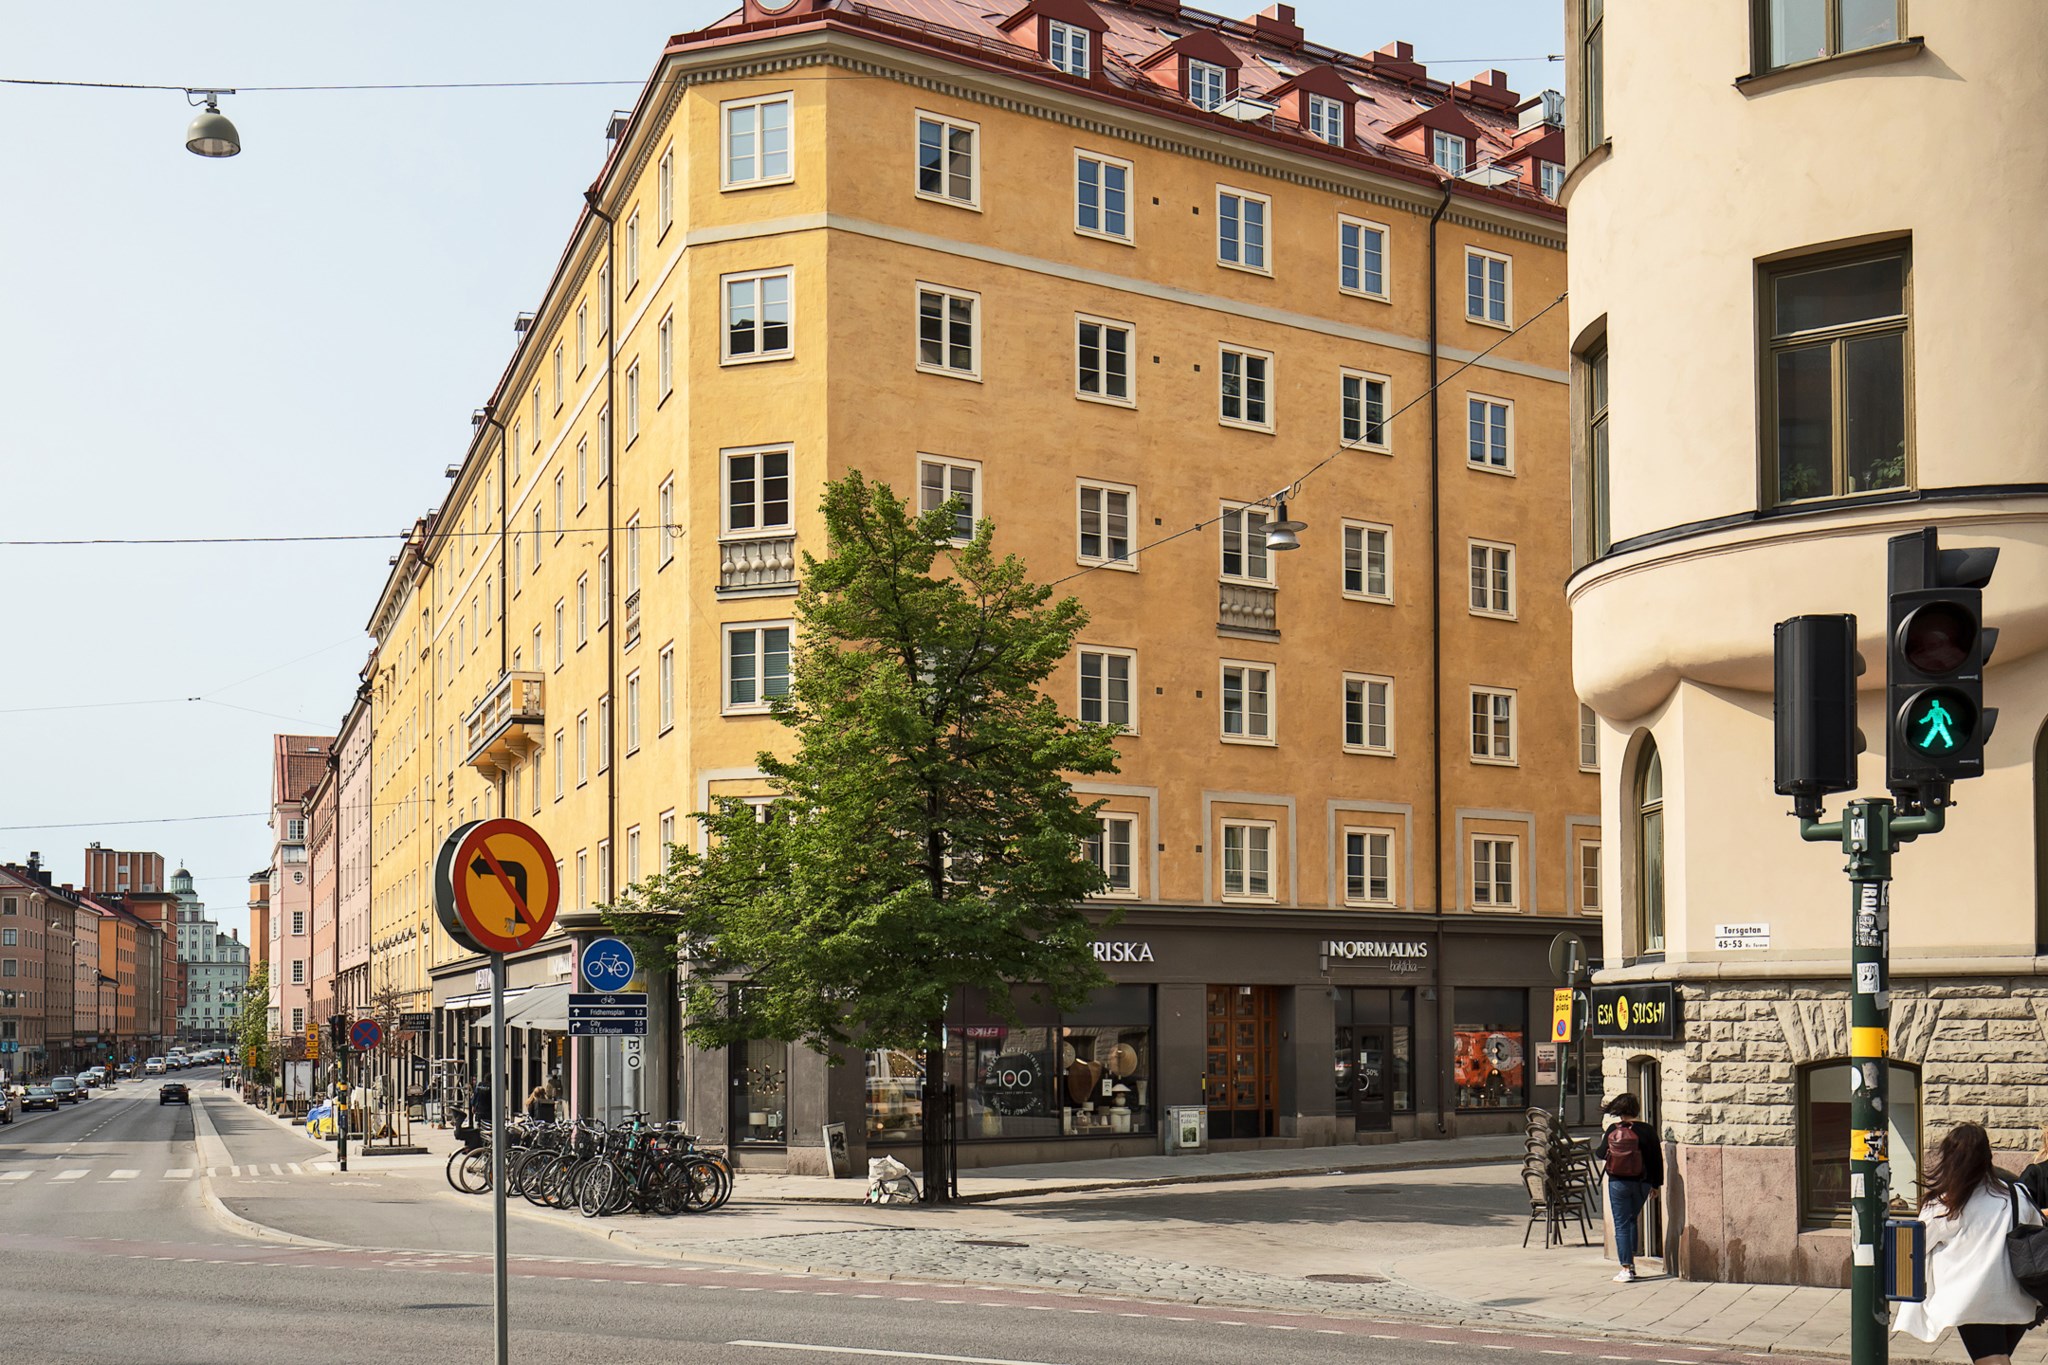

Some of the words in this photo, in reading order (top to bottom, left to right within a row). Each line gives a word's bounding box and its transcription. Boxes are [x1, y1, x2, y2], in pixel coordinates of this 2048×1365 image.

[1723, 926, 1762, 936] Torsgatan
[1329, 940, 1428, 958] NORRMALMS
[1718, 939, 1743, 949] 45-53
[1555, 993, 1571, 1001] Vänd-
[589, 1008, 625, 1016] Fridhemsplan
[1556, 1003, 1569, 1012] plats
[1597, 1003, 1614, 1025] ESA
[1632, 1001, 1666, 1024] SUSHI
[996, 1069, 1032, 1090] 100
